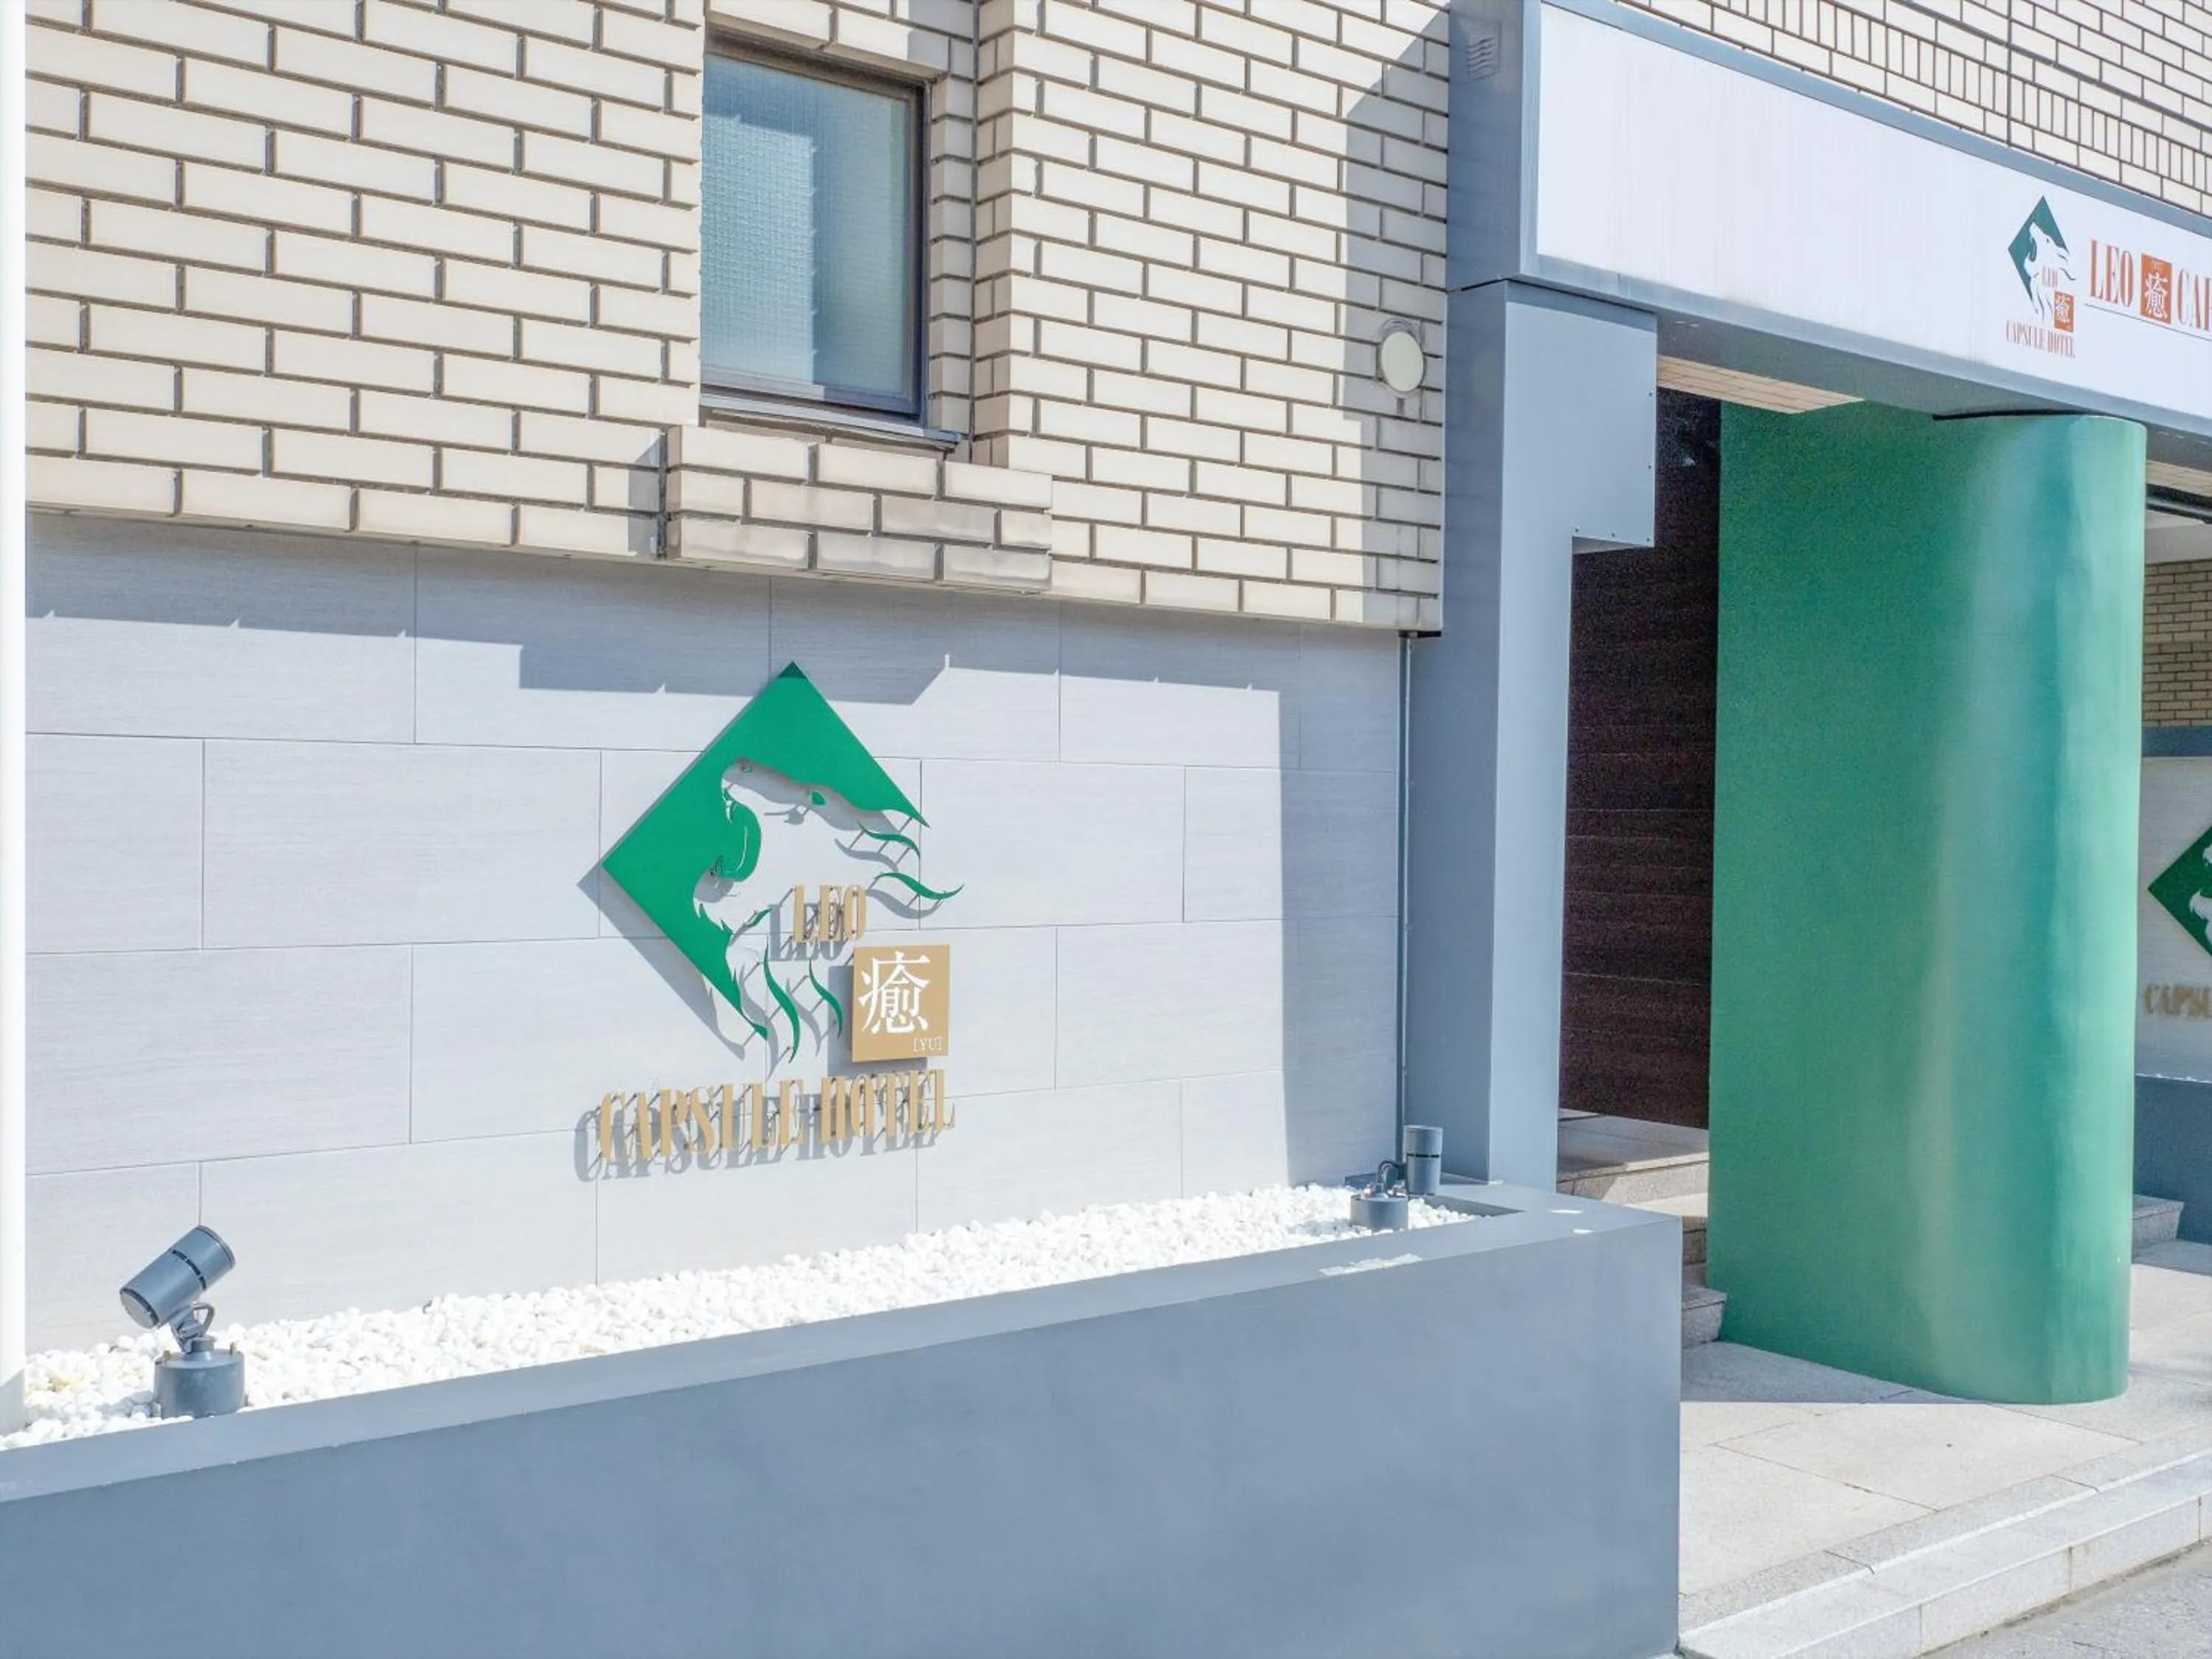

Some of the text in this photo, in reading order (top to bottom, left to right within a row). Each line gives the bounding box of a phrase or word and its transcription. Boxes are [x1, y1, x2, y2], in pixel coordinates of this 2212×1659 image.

[2090, 240, 2134, 307] LEO
[2144, 272, 2168, 319] 癒
[2006, 319, 2076, 359] CAPSULE HOTEL
[793, 884, 866, 942] LEO
[858, 950, 931, 1034] 癒
[599, 1068, 956, 1160] CAPSULE HOTEL
